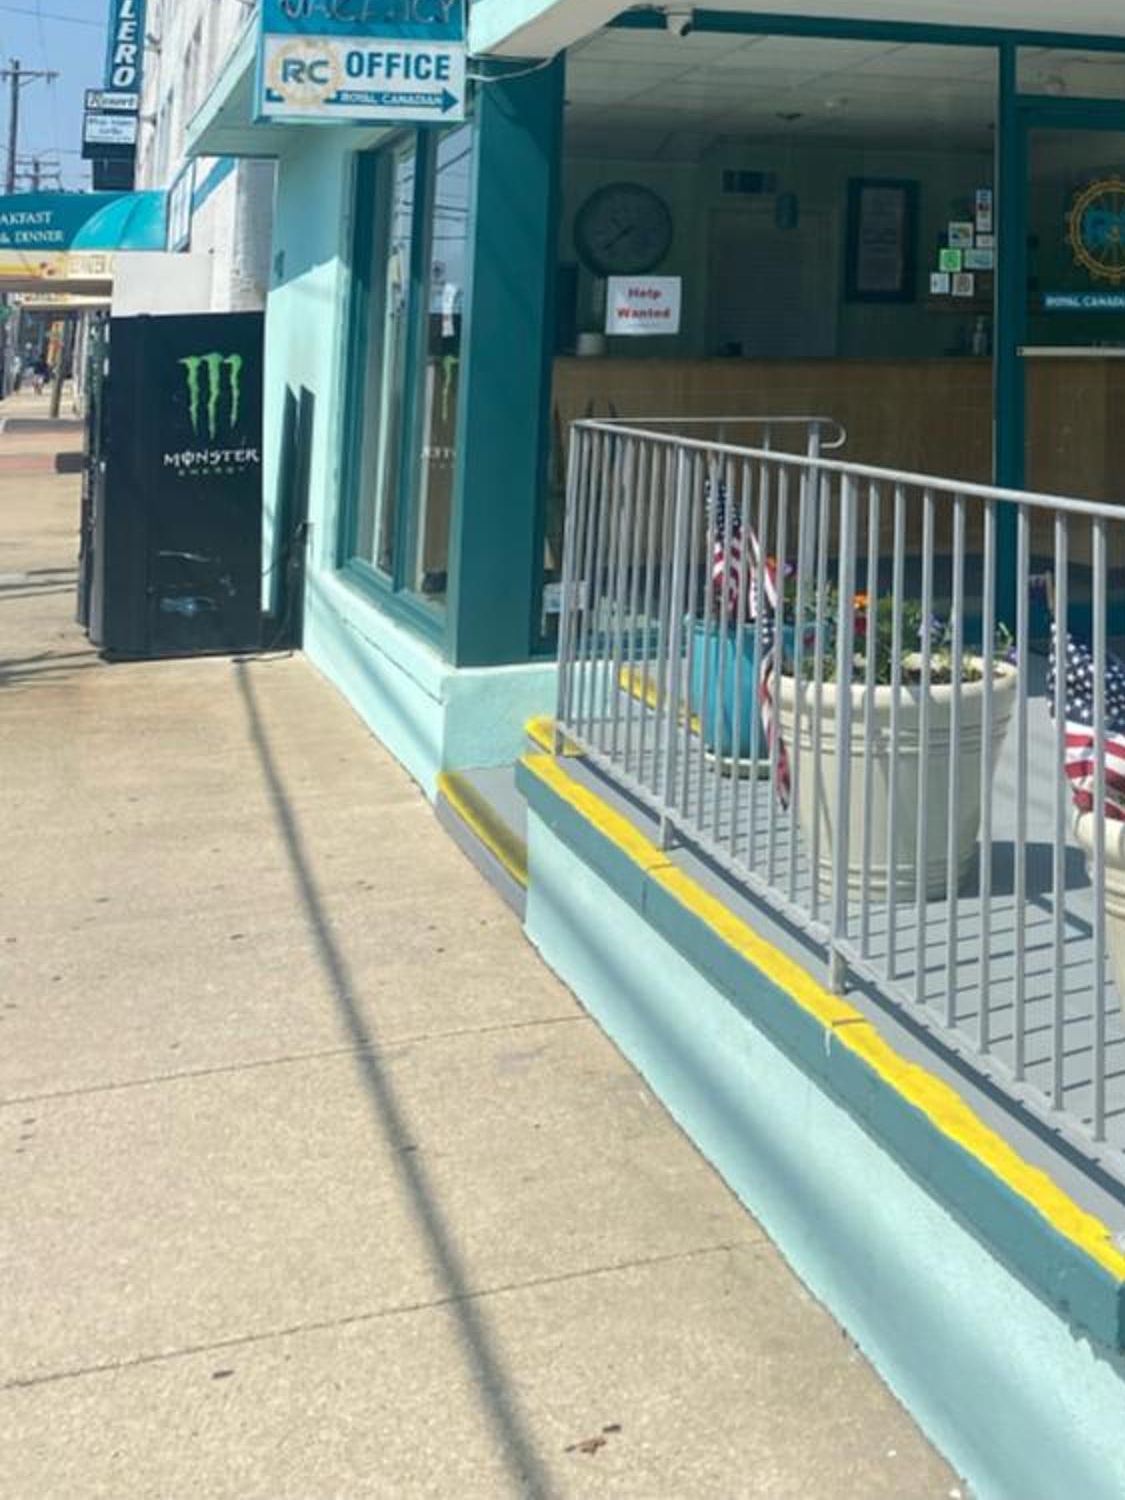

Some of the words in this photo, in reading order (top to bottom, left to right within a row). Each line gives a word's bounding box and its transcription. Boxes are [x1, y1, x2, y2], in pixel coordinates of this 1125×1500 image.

[281, 58, 329, 83] RC
[345, 50, 450, 80] OFFICE
[628, 288, 661, 300] Help
[617, 307, 671, 319] Wanted
[163, 449, 259, 467] MONSTER
